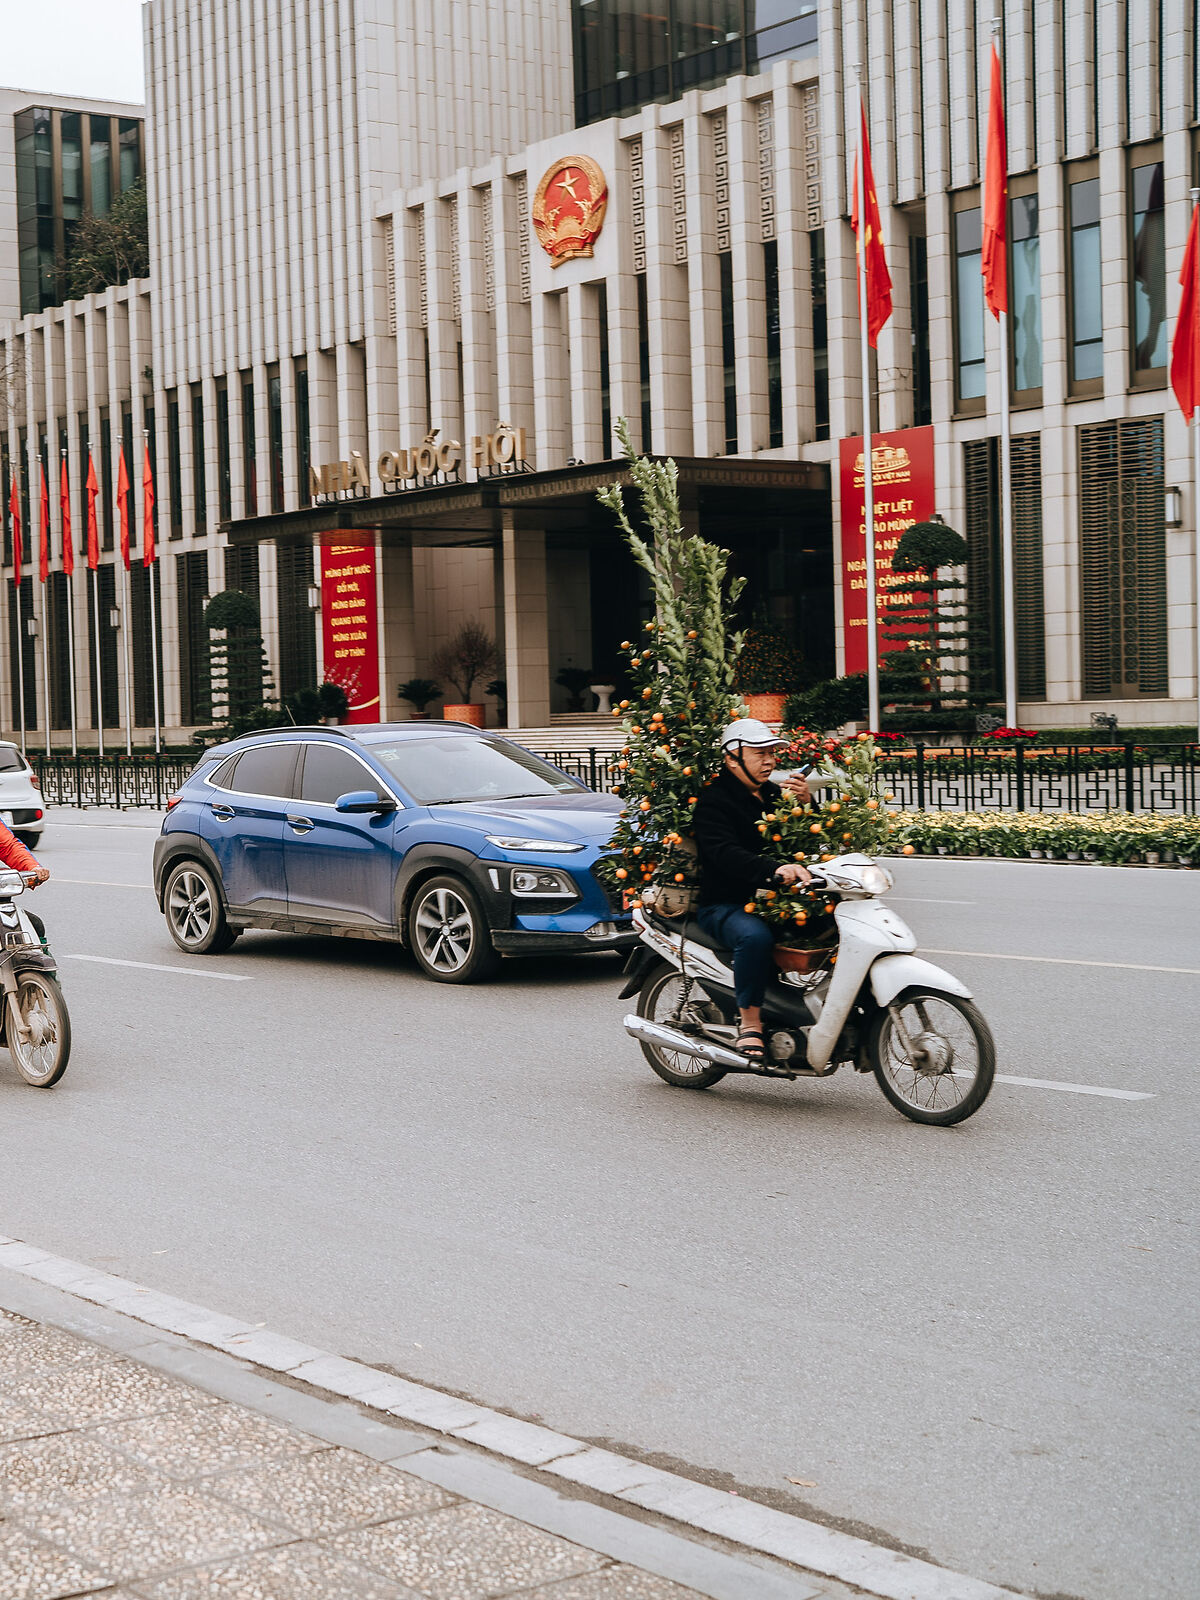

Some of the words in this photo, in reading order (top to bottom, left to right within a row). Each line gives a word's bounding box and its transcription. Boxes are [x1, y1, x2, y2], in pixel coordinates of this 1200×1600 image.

[310, 450, 370, 495] NHÀ
[377, 428, 462, 483] QUỐC
[471, 421, 527, 471] HỘI
[860, 501, 890, 516] NIỆT
[890, 498, 914, 514] LIỆT
[859, 520, 887, 534] CÀO
[883, 537, 901, 550] NĂ
[847, 558, 867, 572] NGÀ
[889, 593, 913, 605] NAM
